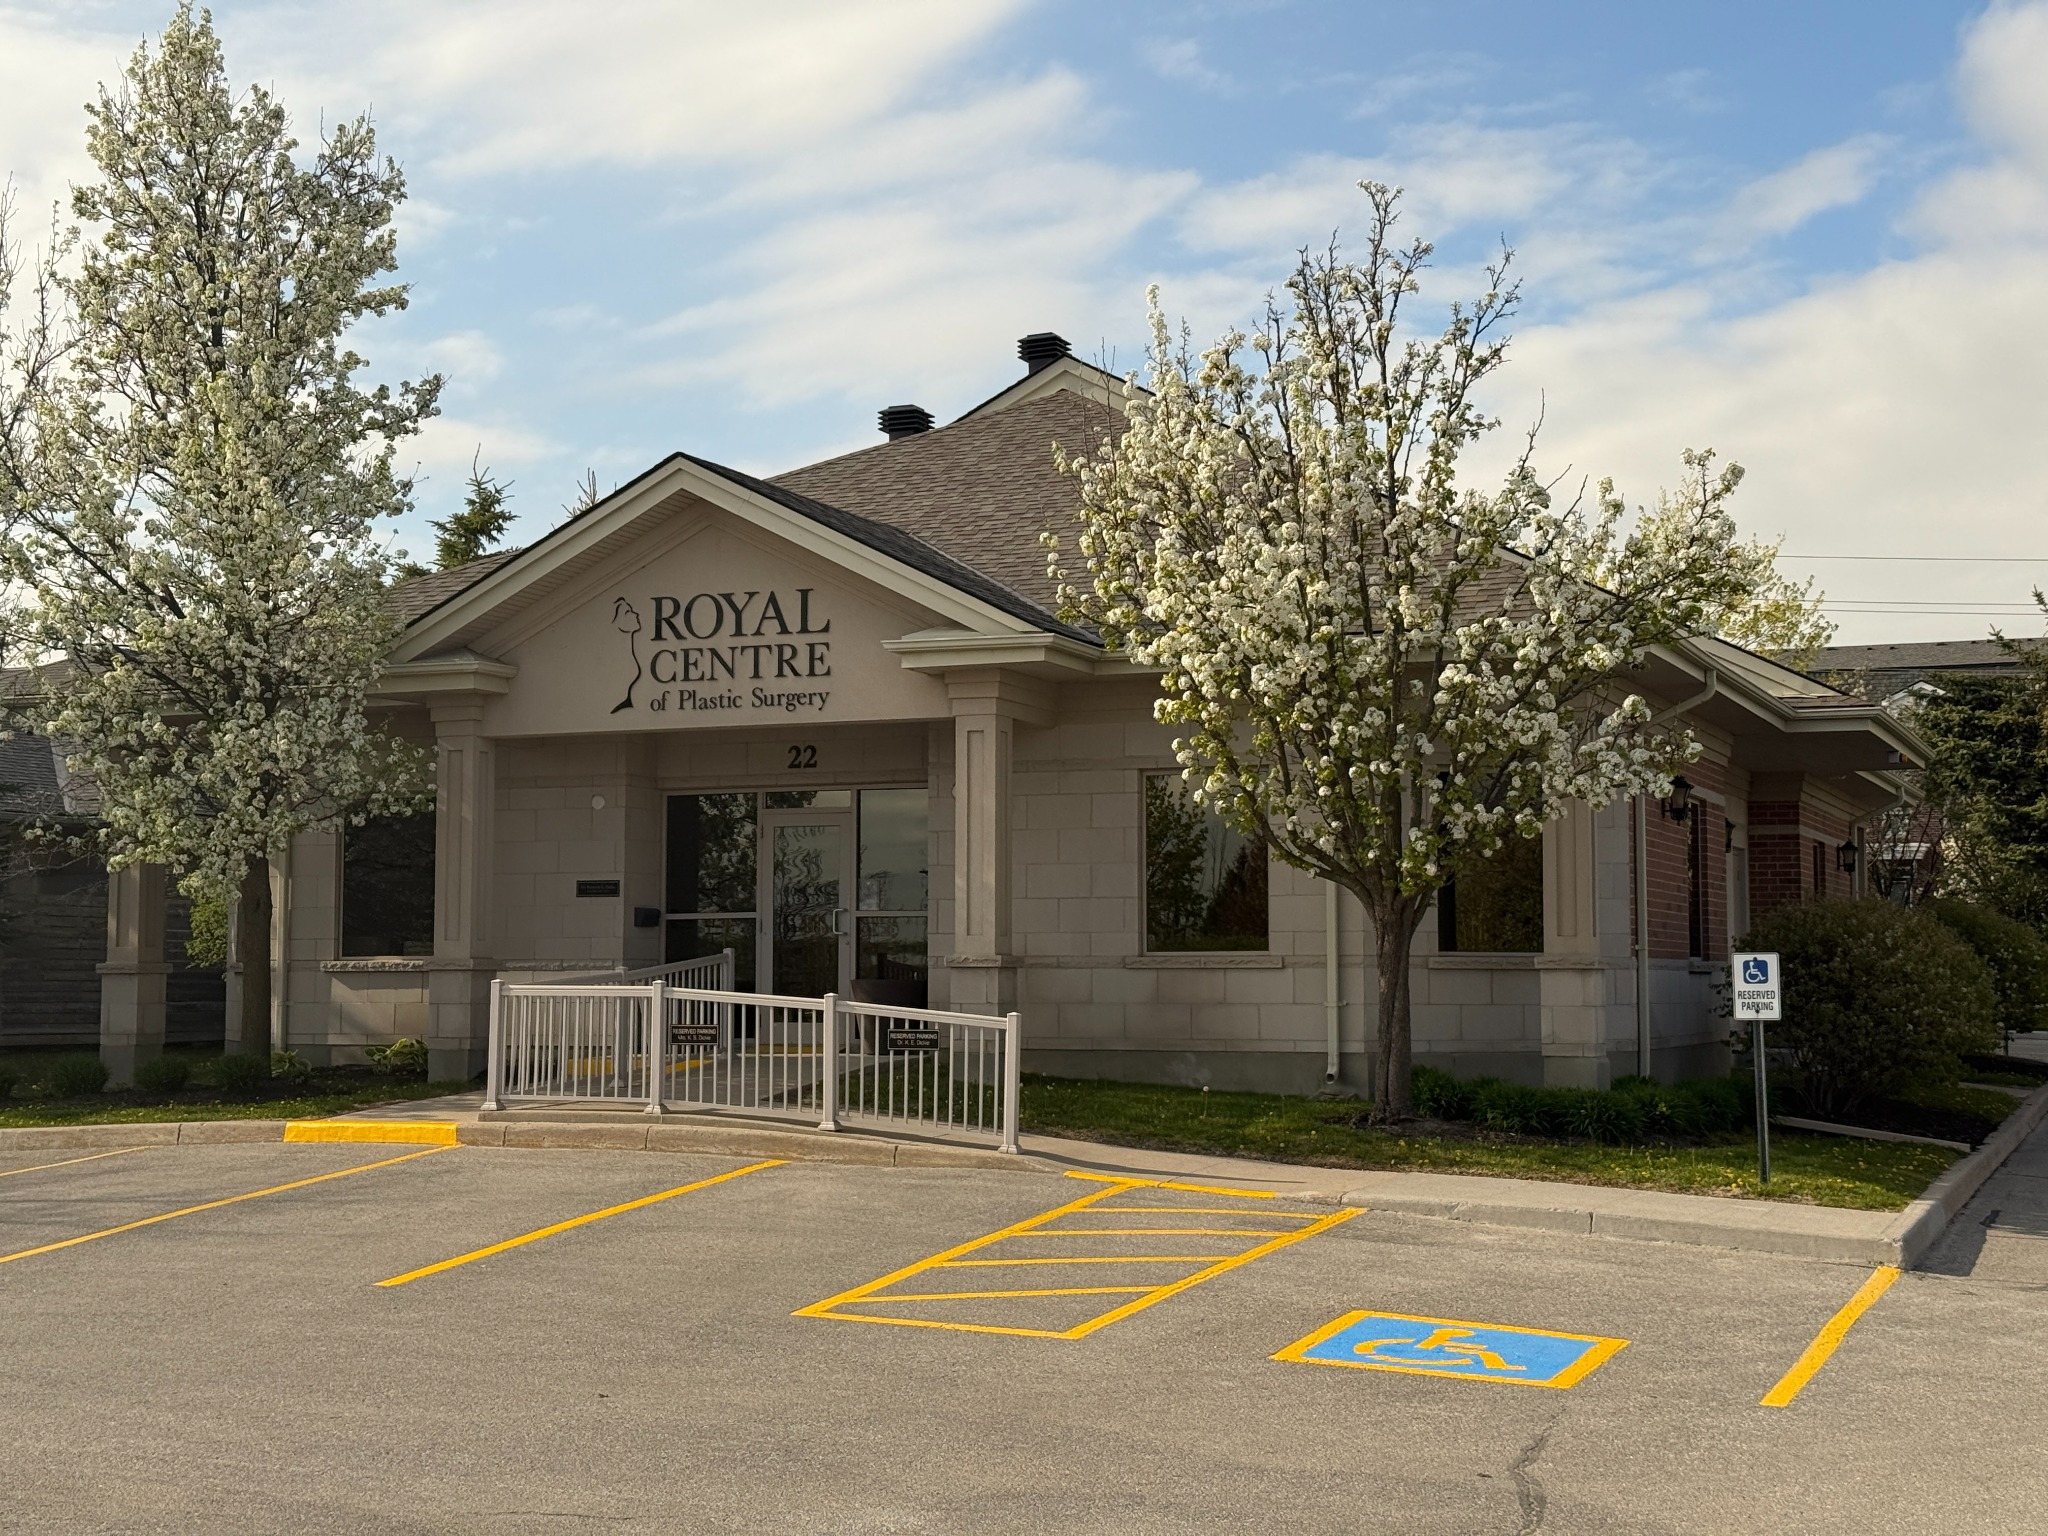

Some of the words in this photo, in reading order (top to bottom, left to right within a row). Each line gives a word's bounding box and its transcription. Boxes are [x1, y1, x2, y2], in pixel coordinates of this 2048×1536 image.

[650, 588, 831, 641] ROYAL
[650, 641, 831, 683] CENTRE
[650, 690, 670, 711] of
[678, 689, 743, 711] Plastic
[751, 687, 830, 711] Surgery
[787, 745, 818, 769] 22
[1737, 990, 1776, 1000] RESERVED
[1741, 1001, 1774, 1011] PARKING
